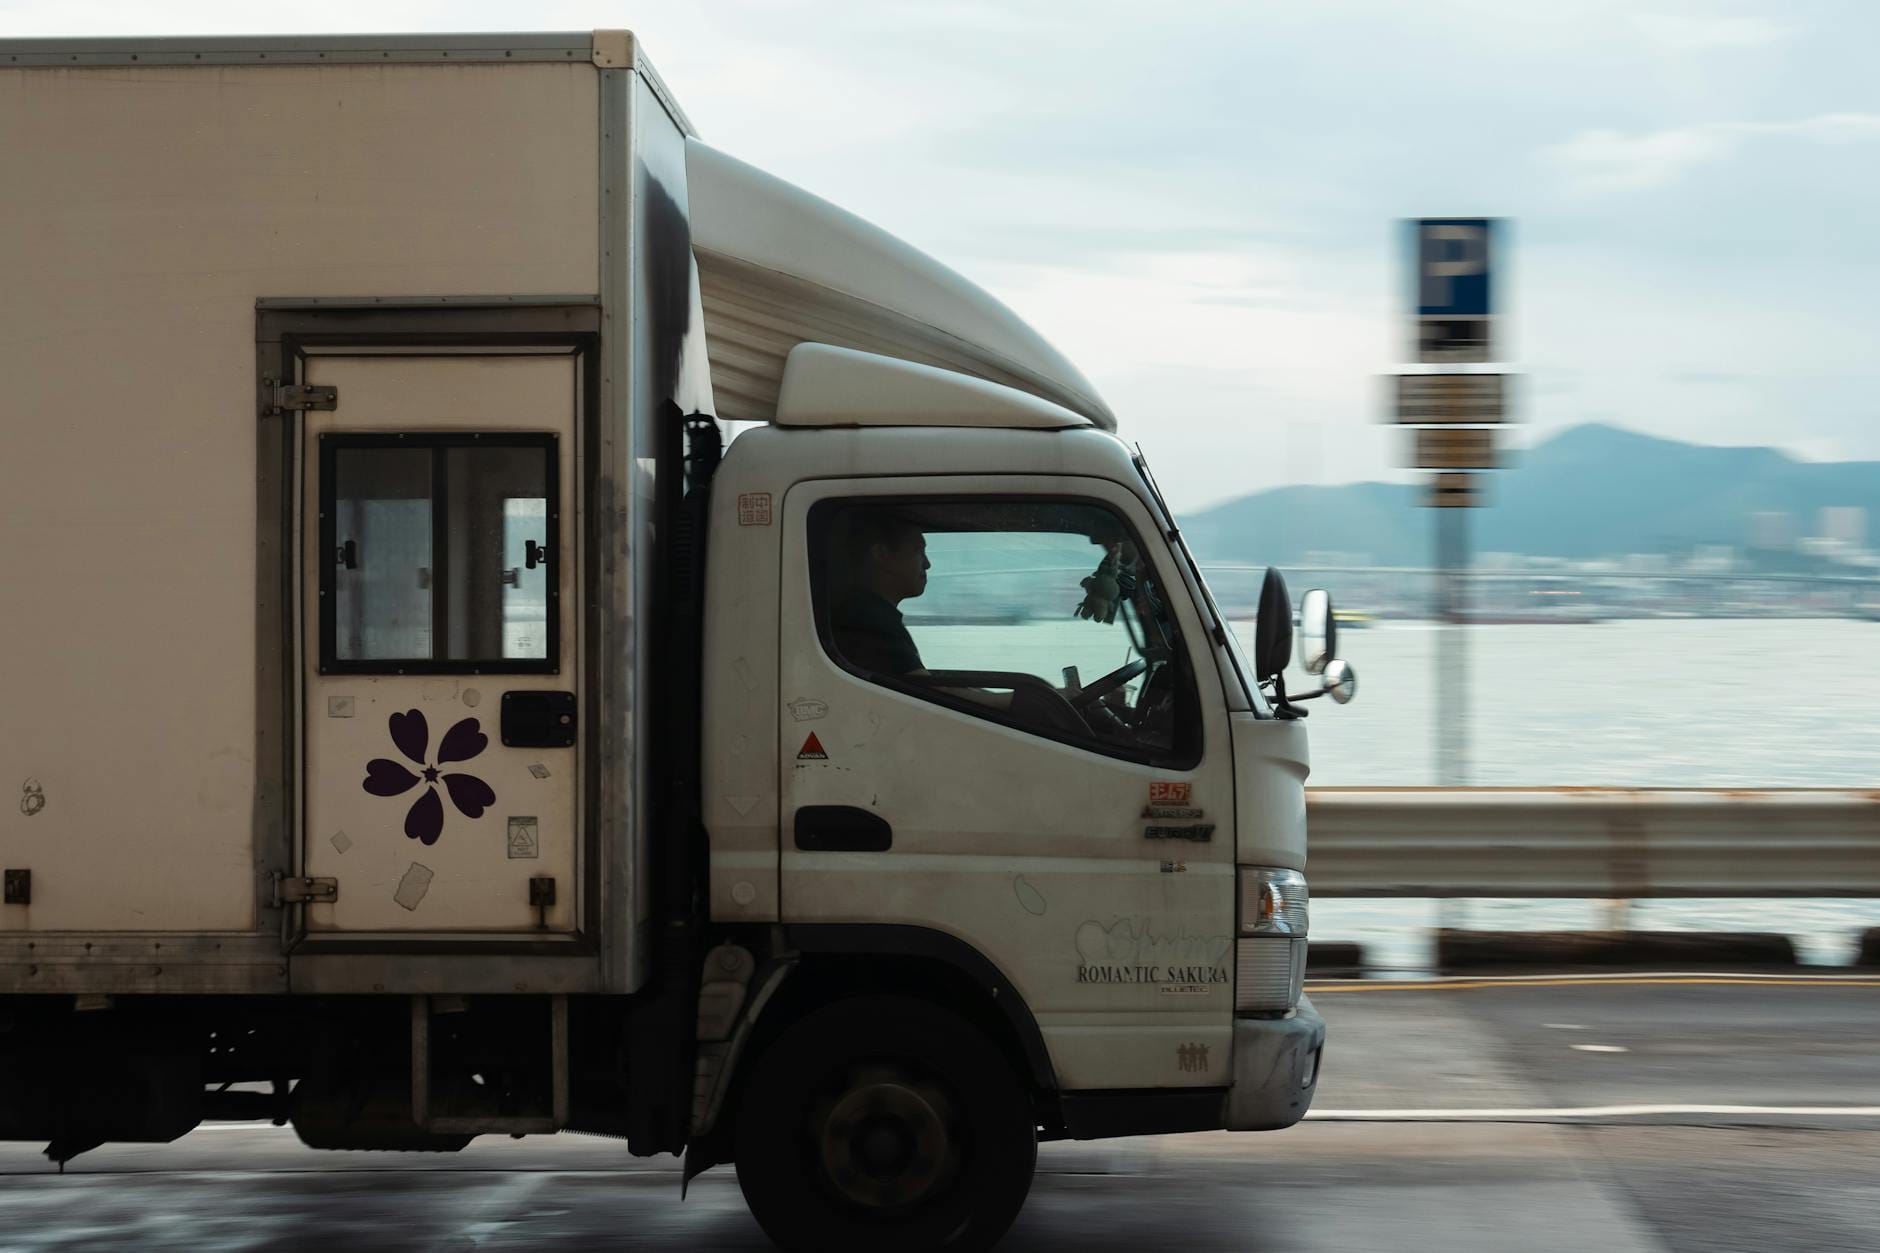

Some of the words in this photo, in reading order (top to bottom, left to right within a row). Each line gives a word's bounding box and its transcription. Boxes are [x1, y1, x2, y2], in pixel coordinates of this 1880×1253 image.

[1151, 783, 1186, 800] ヨシムラ
[1078, 965, 1160, 983] ROMANTIC
[1167, 965, 1229, 983] SAKURA
